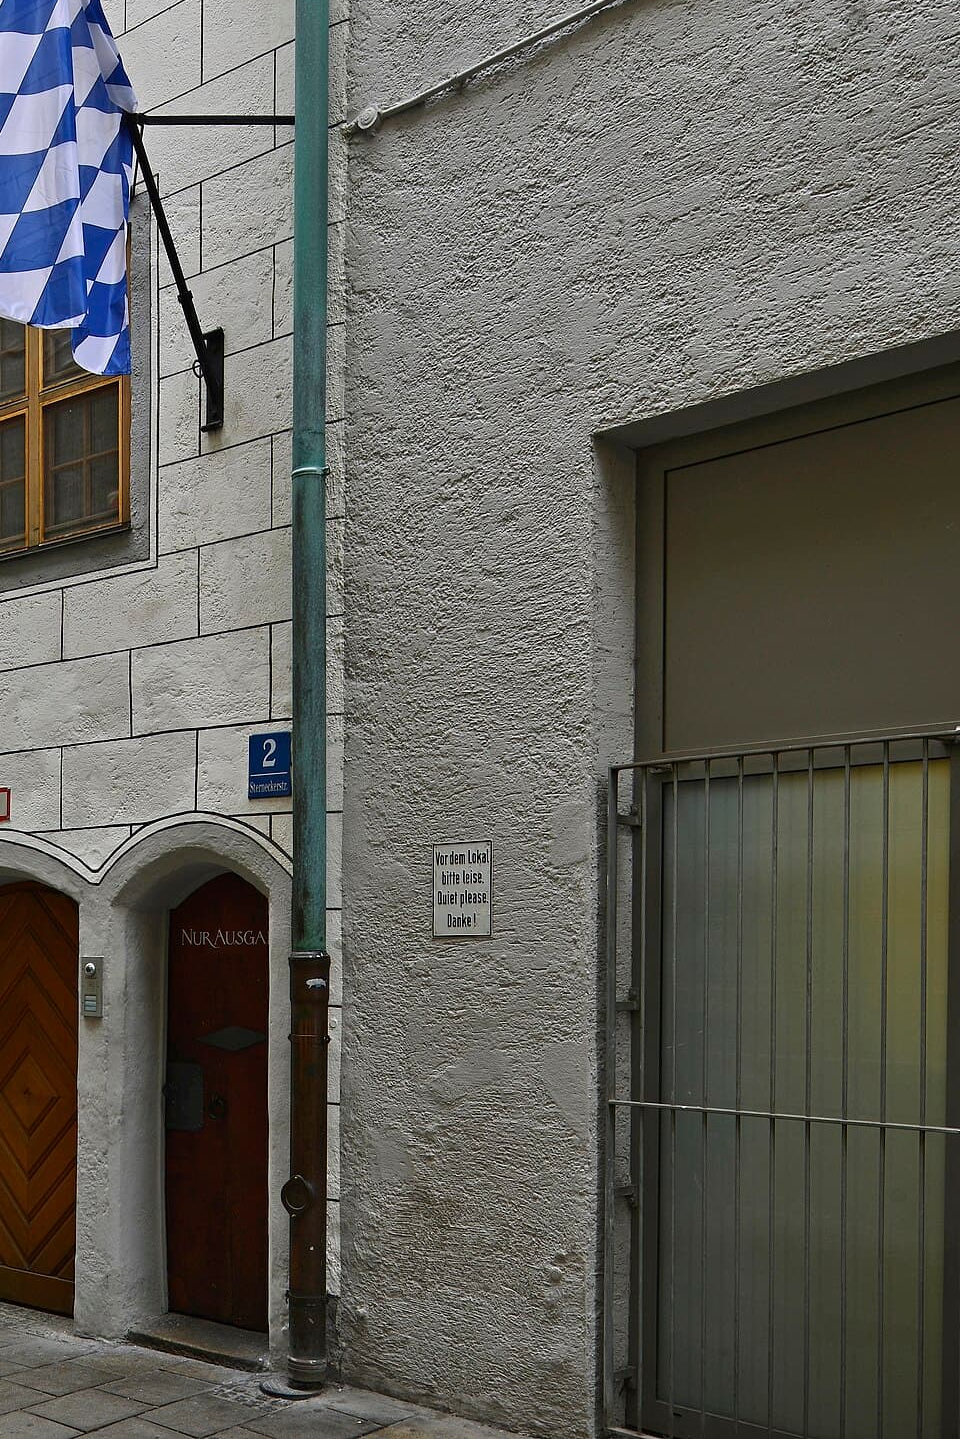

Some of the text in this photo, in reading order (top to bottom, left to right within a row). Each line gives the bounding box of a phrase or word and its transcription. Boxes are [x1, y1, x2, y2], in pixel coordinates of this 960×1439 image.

[262, 738, 276, 767] 2
[435, 849, 489, 866] Vor dem Lokal
[441, 870, 485, 885] bitte leise.
[437, 890, 489, 908] Quiet please.
[181, 928, 268, 948] NUR AUSGA
